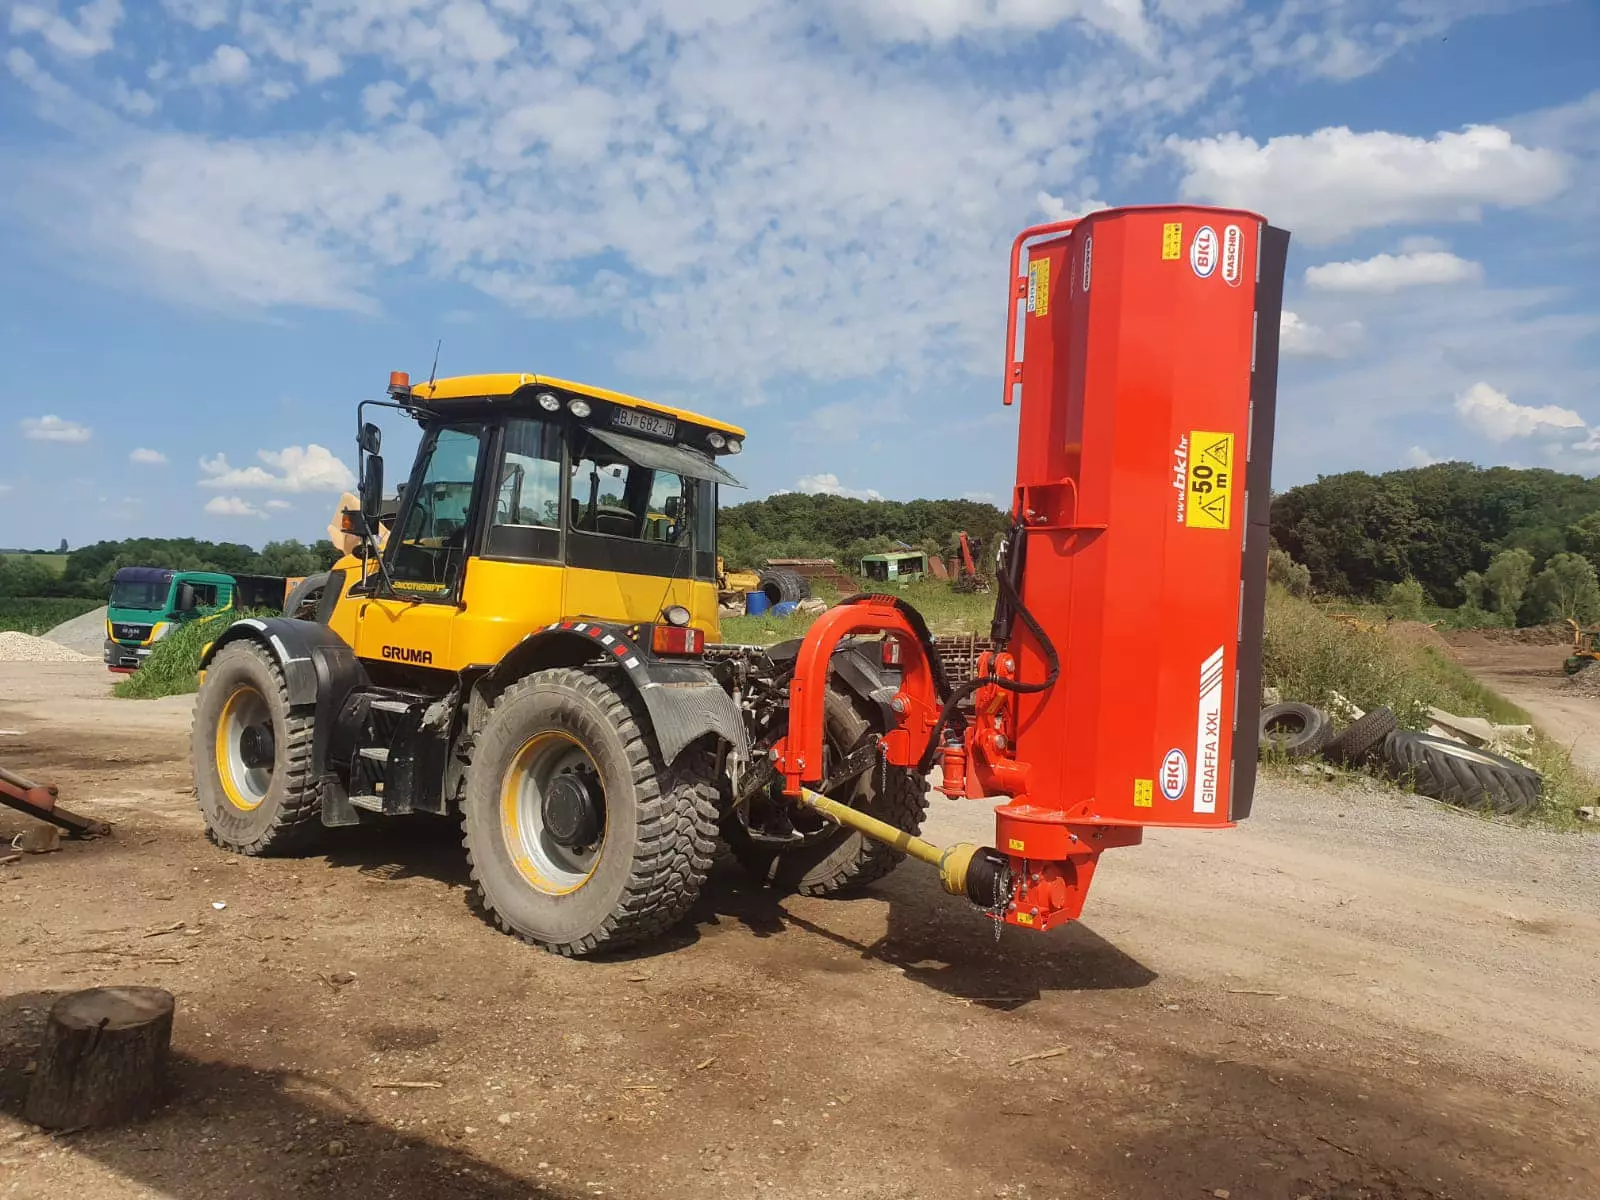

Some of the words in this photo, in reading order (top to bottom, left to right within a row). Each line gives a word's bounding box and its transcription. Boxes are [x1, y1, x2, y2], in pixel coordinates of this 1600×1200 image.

[1197, 233, 1210, 267] BKL
[1226, 228, 1237, 278] MASCHIO
[620, 410, 634, 426] BJ
[639, 415, 675, 436] 682-JD
[1191, 465, 1213, 494] 50
[1217, 473, 1228, 488] m
[381, 645, 433, 664] GRUMA
[1205, 708, 1219, 736] XXL
[1166, 755, 1180, 790] BKL
[1202, 741, 1217, 803] GIRAFFA
